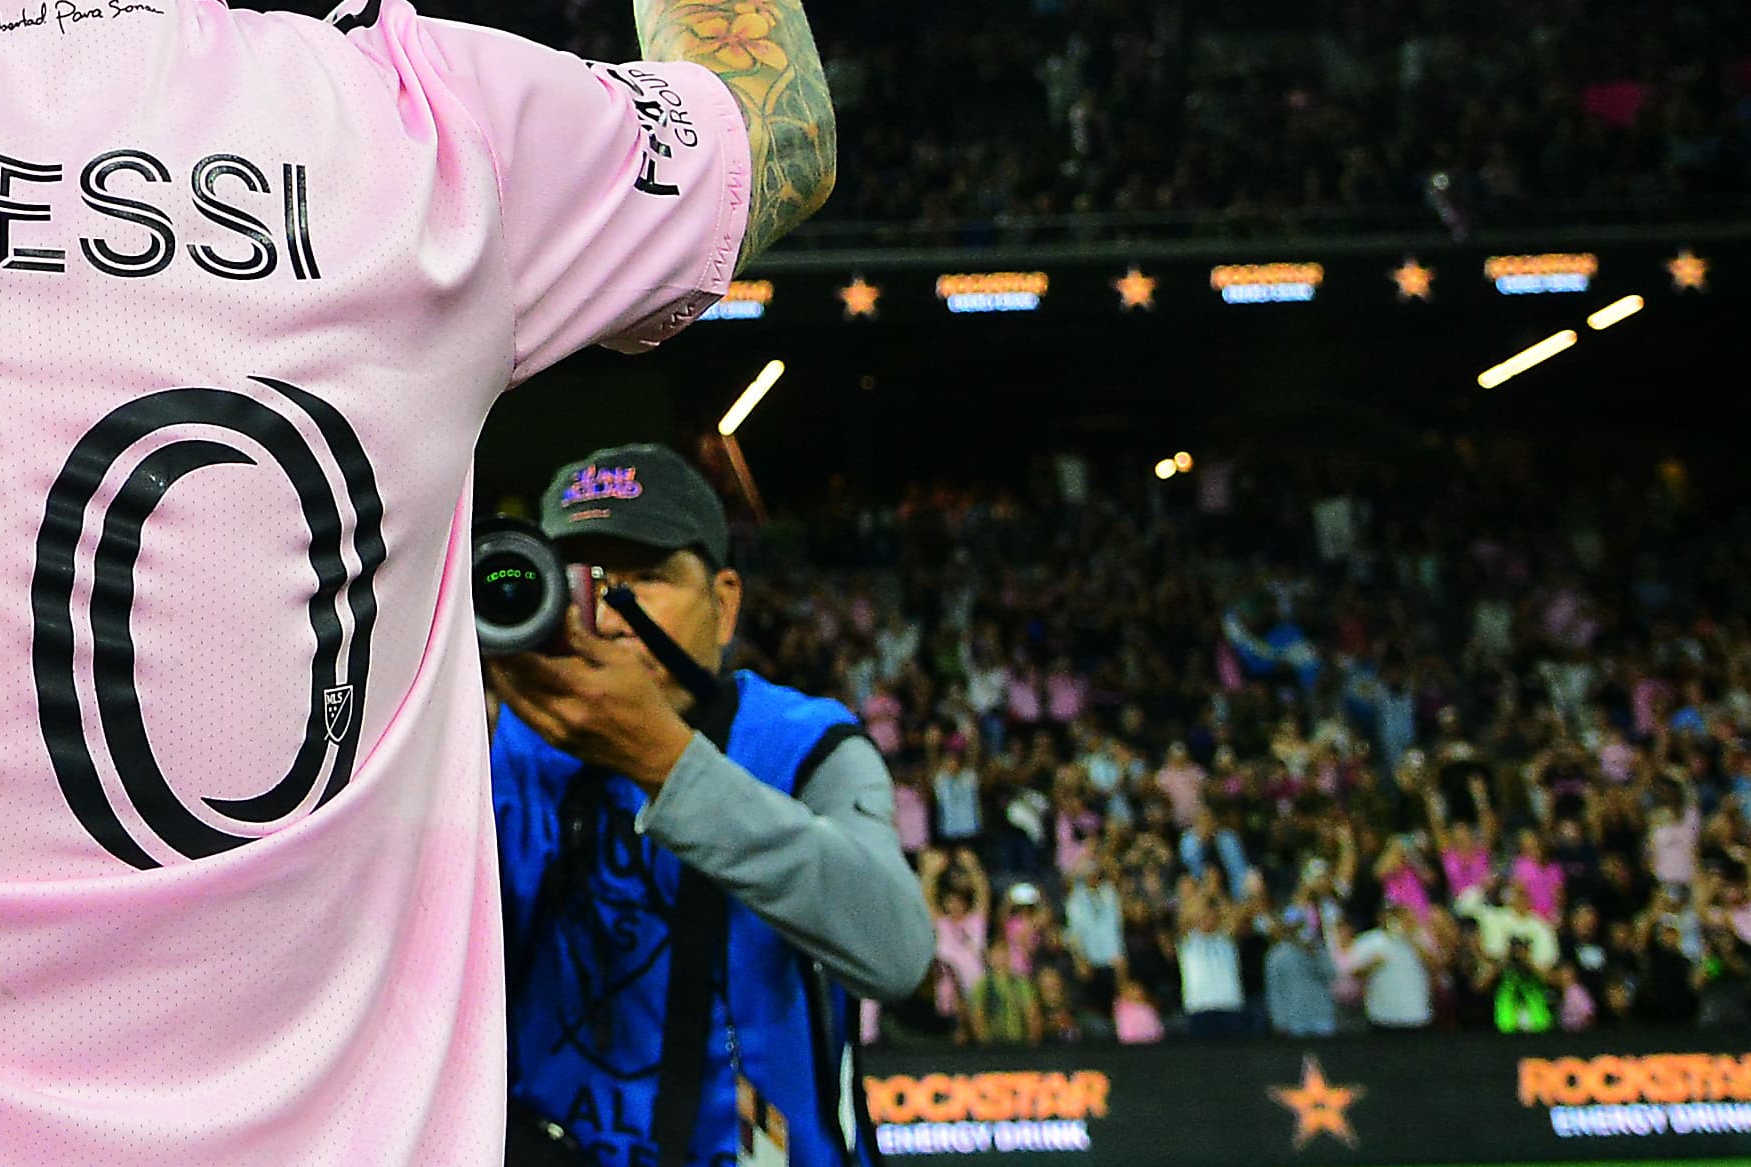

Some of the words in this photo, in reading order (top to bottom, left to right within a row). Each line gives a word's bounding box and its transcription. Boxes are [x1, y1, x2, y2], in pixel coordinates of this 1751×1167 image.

[54, 0, 104, 35] Para
[628, 68, 699, 148] GROUP
[325, 691, 343, 705] MLS
[875, 1122, 993, 1156] ENERGY
[994, 1118, 1093, 1153] DRINK
